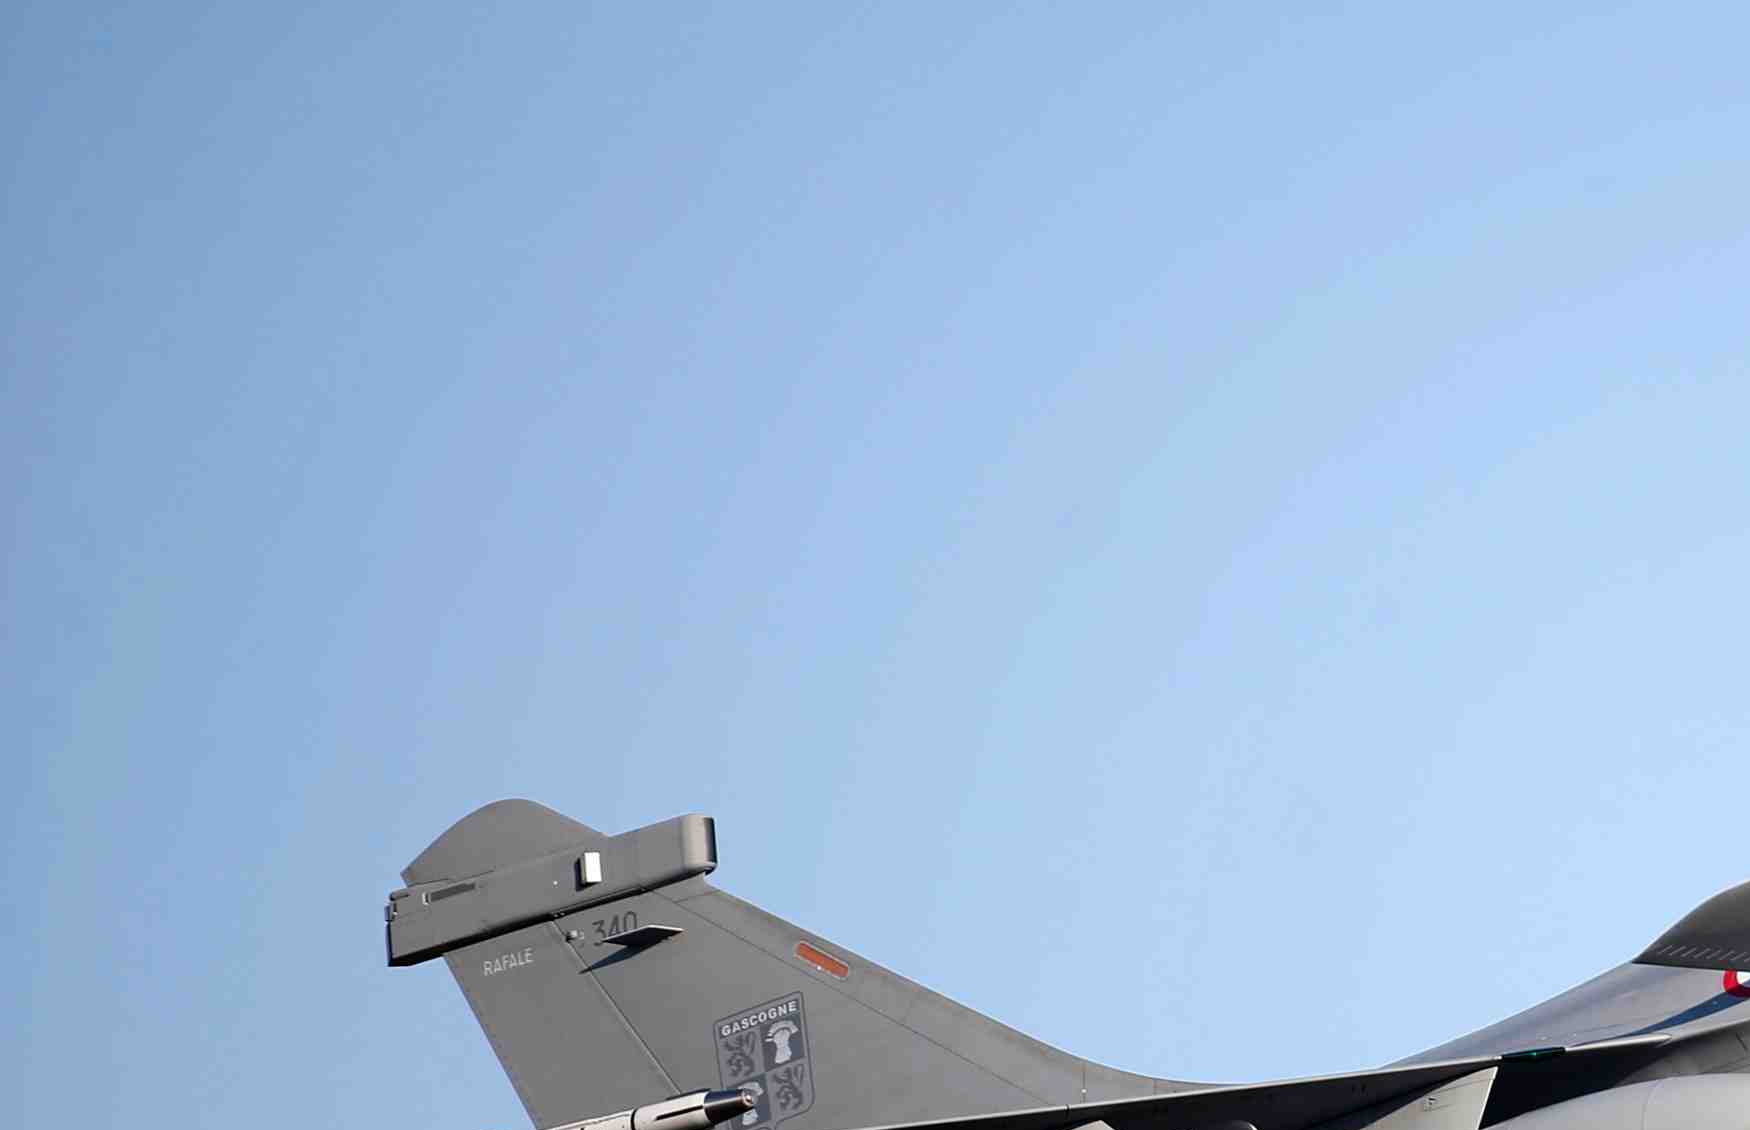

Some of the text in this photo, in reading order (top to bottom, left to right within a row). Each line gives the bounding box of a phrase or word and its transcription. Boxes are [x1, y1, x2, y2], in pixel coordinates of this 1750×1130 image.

[592, 911, 638, 946] 340
[483, 947, 535, 977] RAFALE
[721, 1000, 797, 1036] GASCOGNE
